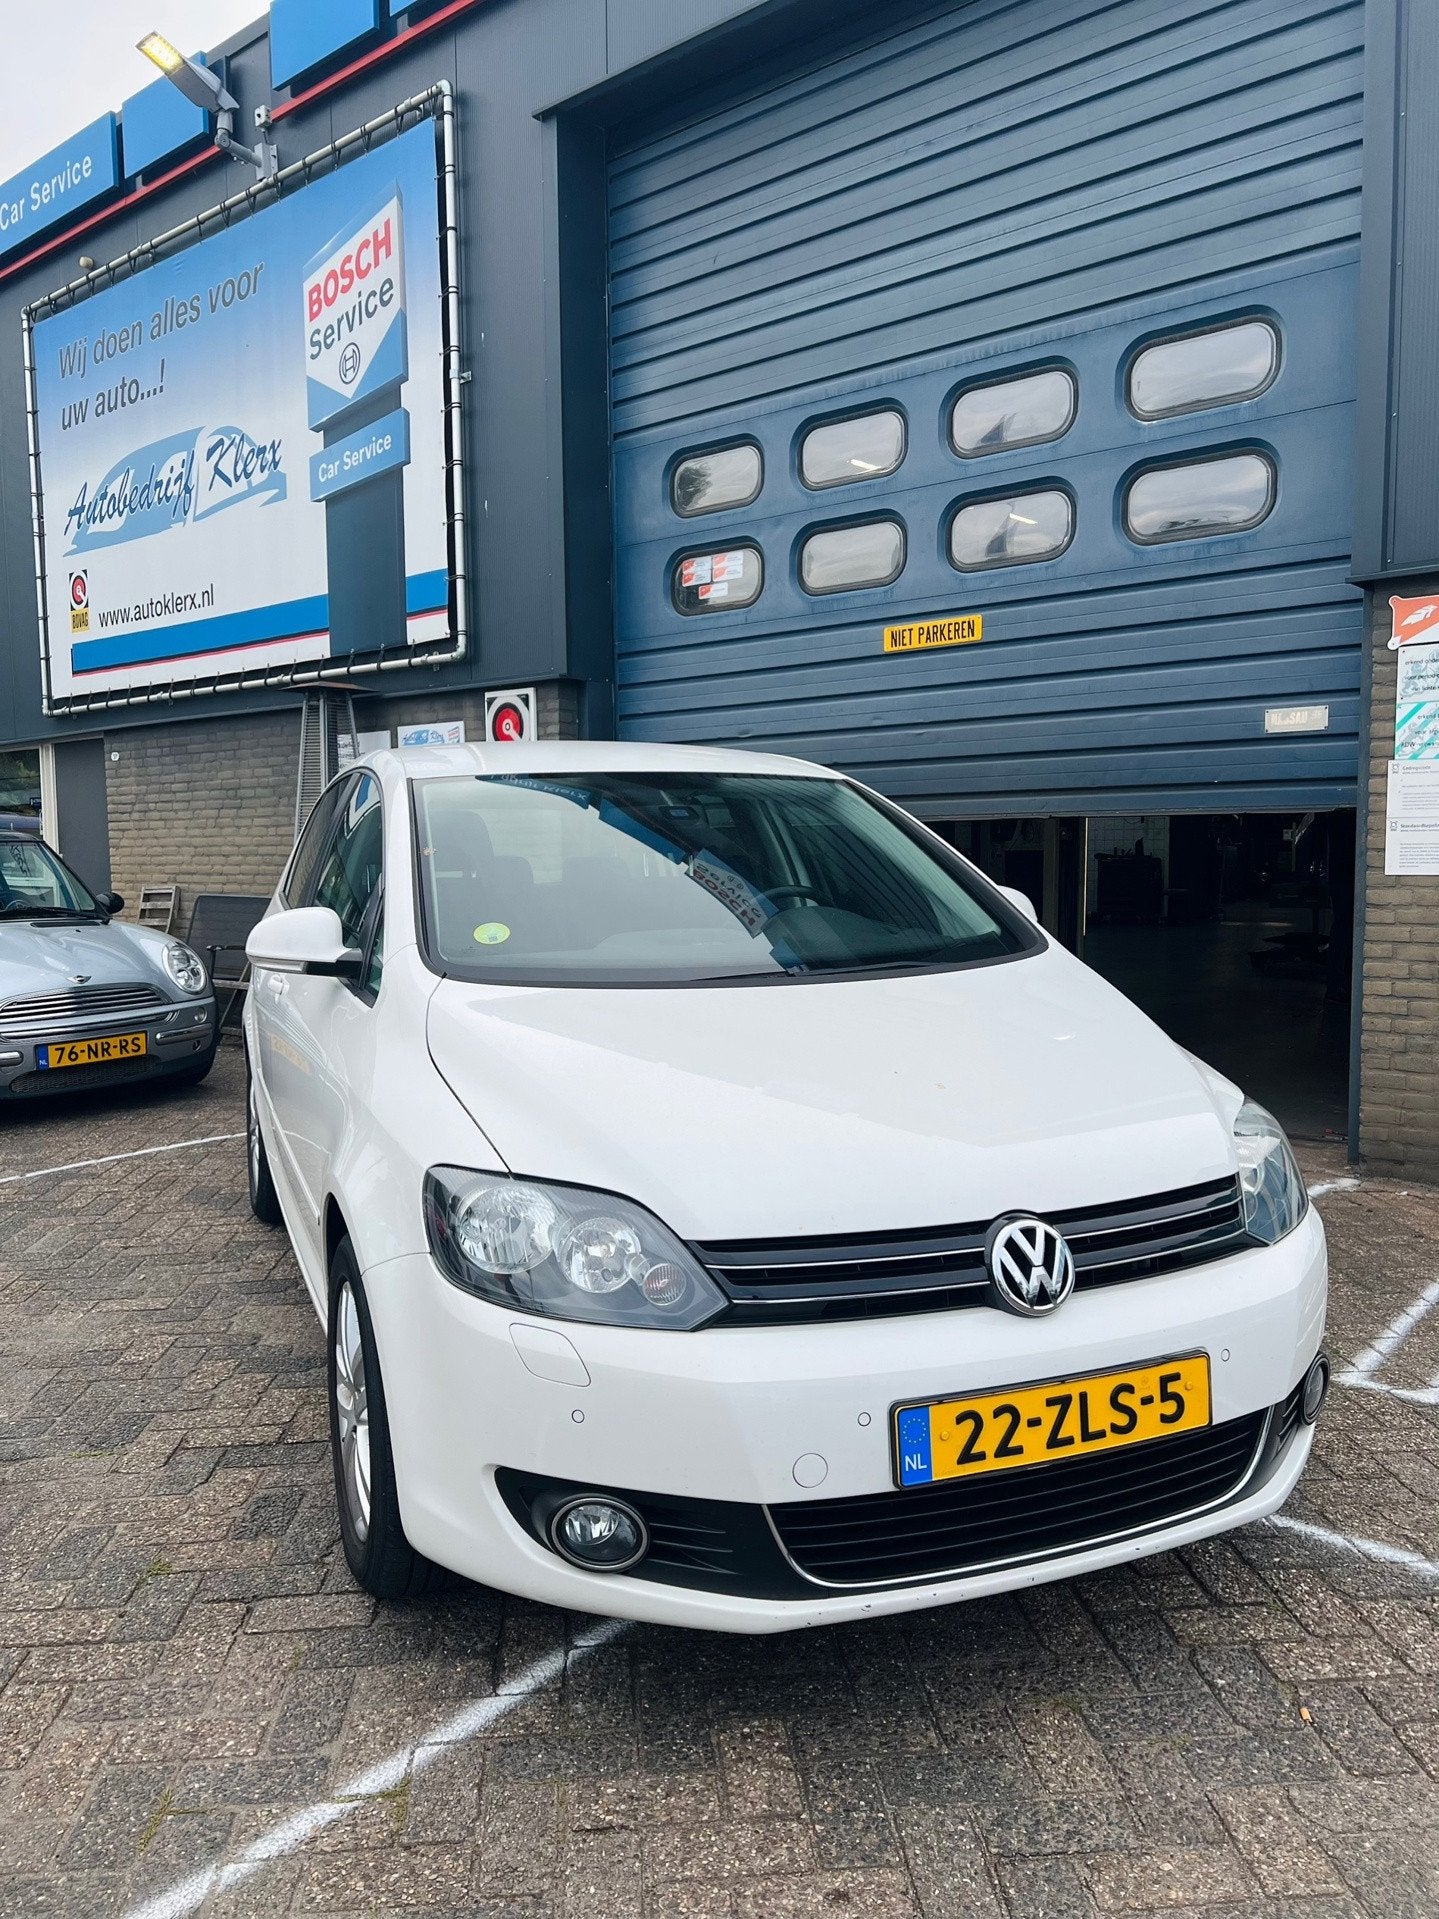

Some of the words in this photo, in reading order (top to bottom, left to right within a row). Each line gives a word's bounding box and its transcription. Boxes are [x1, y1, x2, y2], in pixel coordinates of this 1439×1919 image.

[0, 197, 25, 231] Car
[30, 155, 92, 211] Service
[308, 217, 392, 323] BOSCH
[58, 337, 88, 379] Wij
[93, 319, 143, 365] doen
[150, 295, 200, 341] alles
[208, 262, 265, 314] voor
[309, 277, 394, 361] Service
[61, 398, 90, 431] uw
[63, 448, 195, 536] Autobedrijf
[206, 432, 282, 492] Klerx
[318, 459, 340, 482] Car
[342, 434, 392, 470] Service
[98, 582, 214, 628] www.autoklerx.nl
[890, 627, 914, 648] NIET
[918, 619, 975, 645] PARKEREN
[54, 1036, 142, 1064] 76-NR-RS
[905, 1453, 928, 1471] NL
[954, 1371, 1186, 1466] 22-ZLS-5
